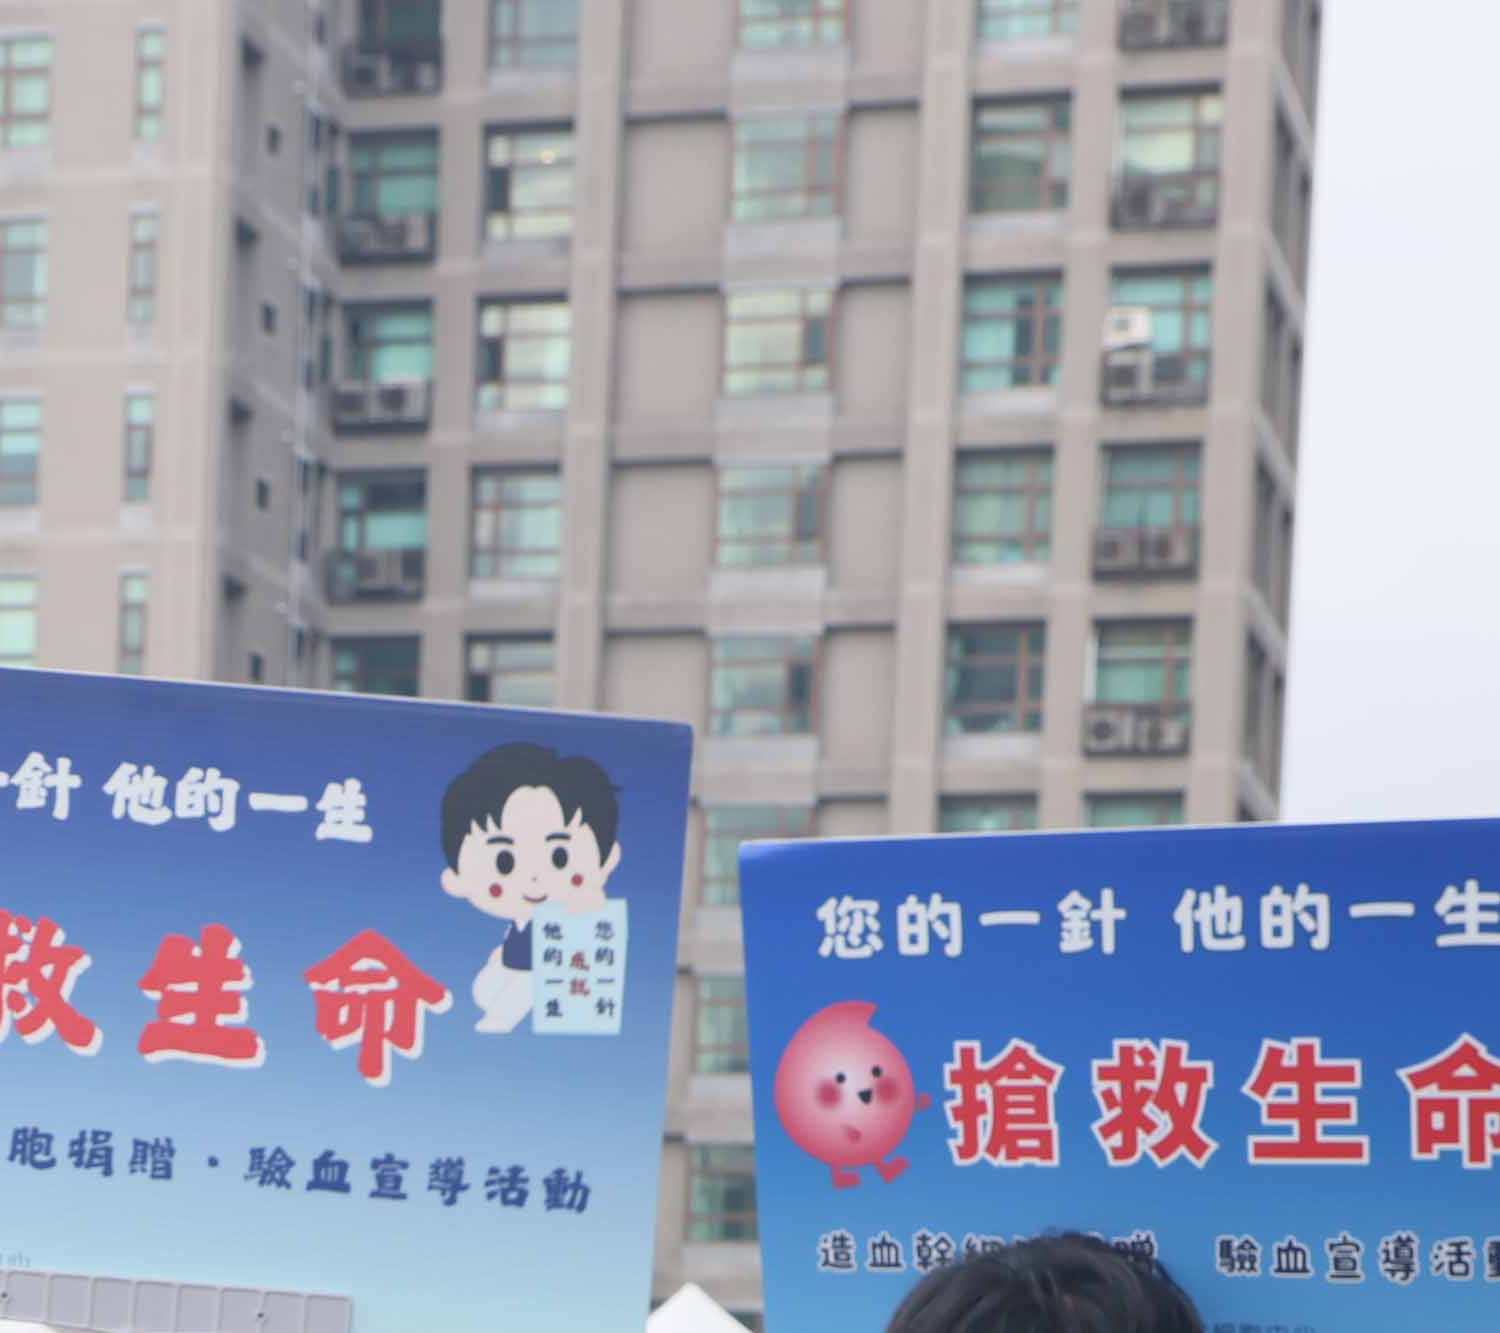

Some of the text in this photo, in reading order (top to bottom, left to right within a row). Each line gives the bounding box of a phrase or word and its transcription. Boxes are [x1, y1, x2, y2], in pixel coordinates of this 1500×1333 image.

[102, 759, 373, 843] 他的一生
[816, 887, 1127, 958] 您的一針
